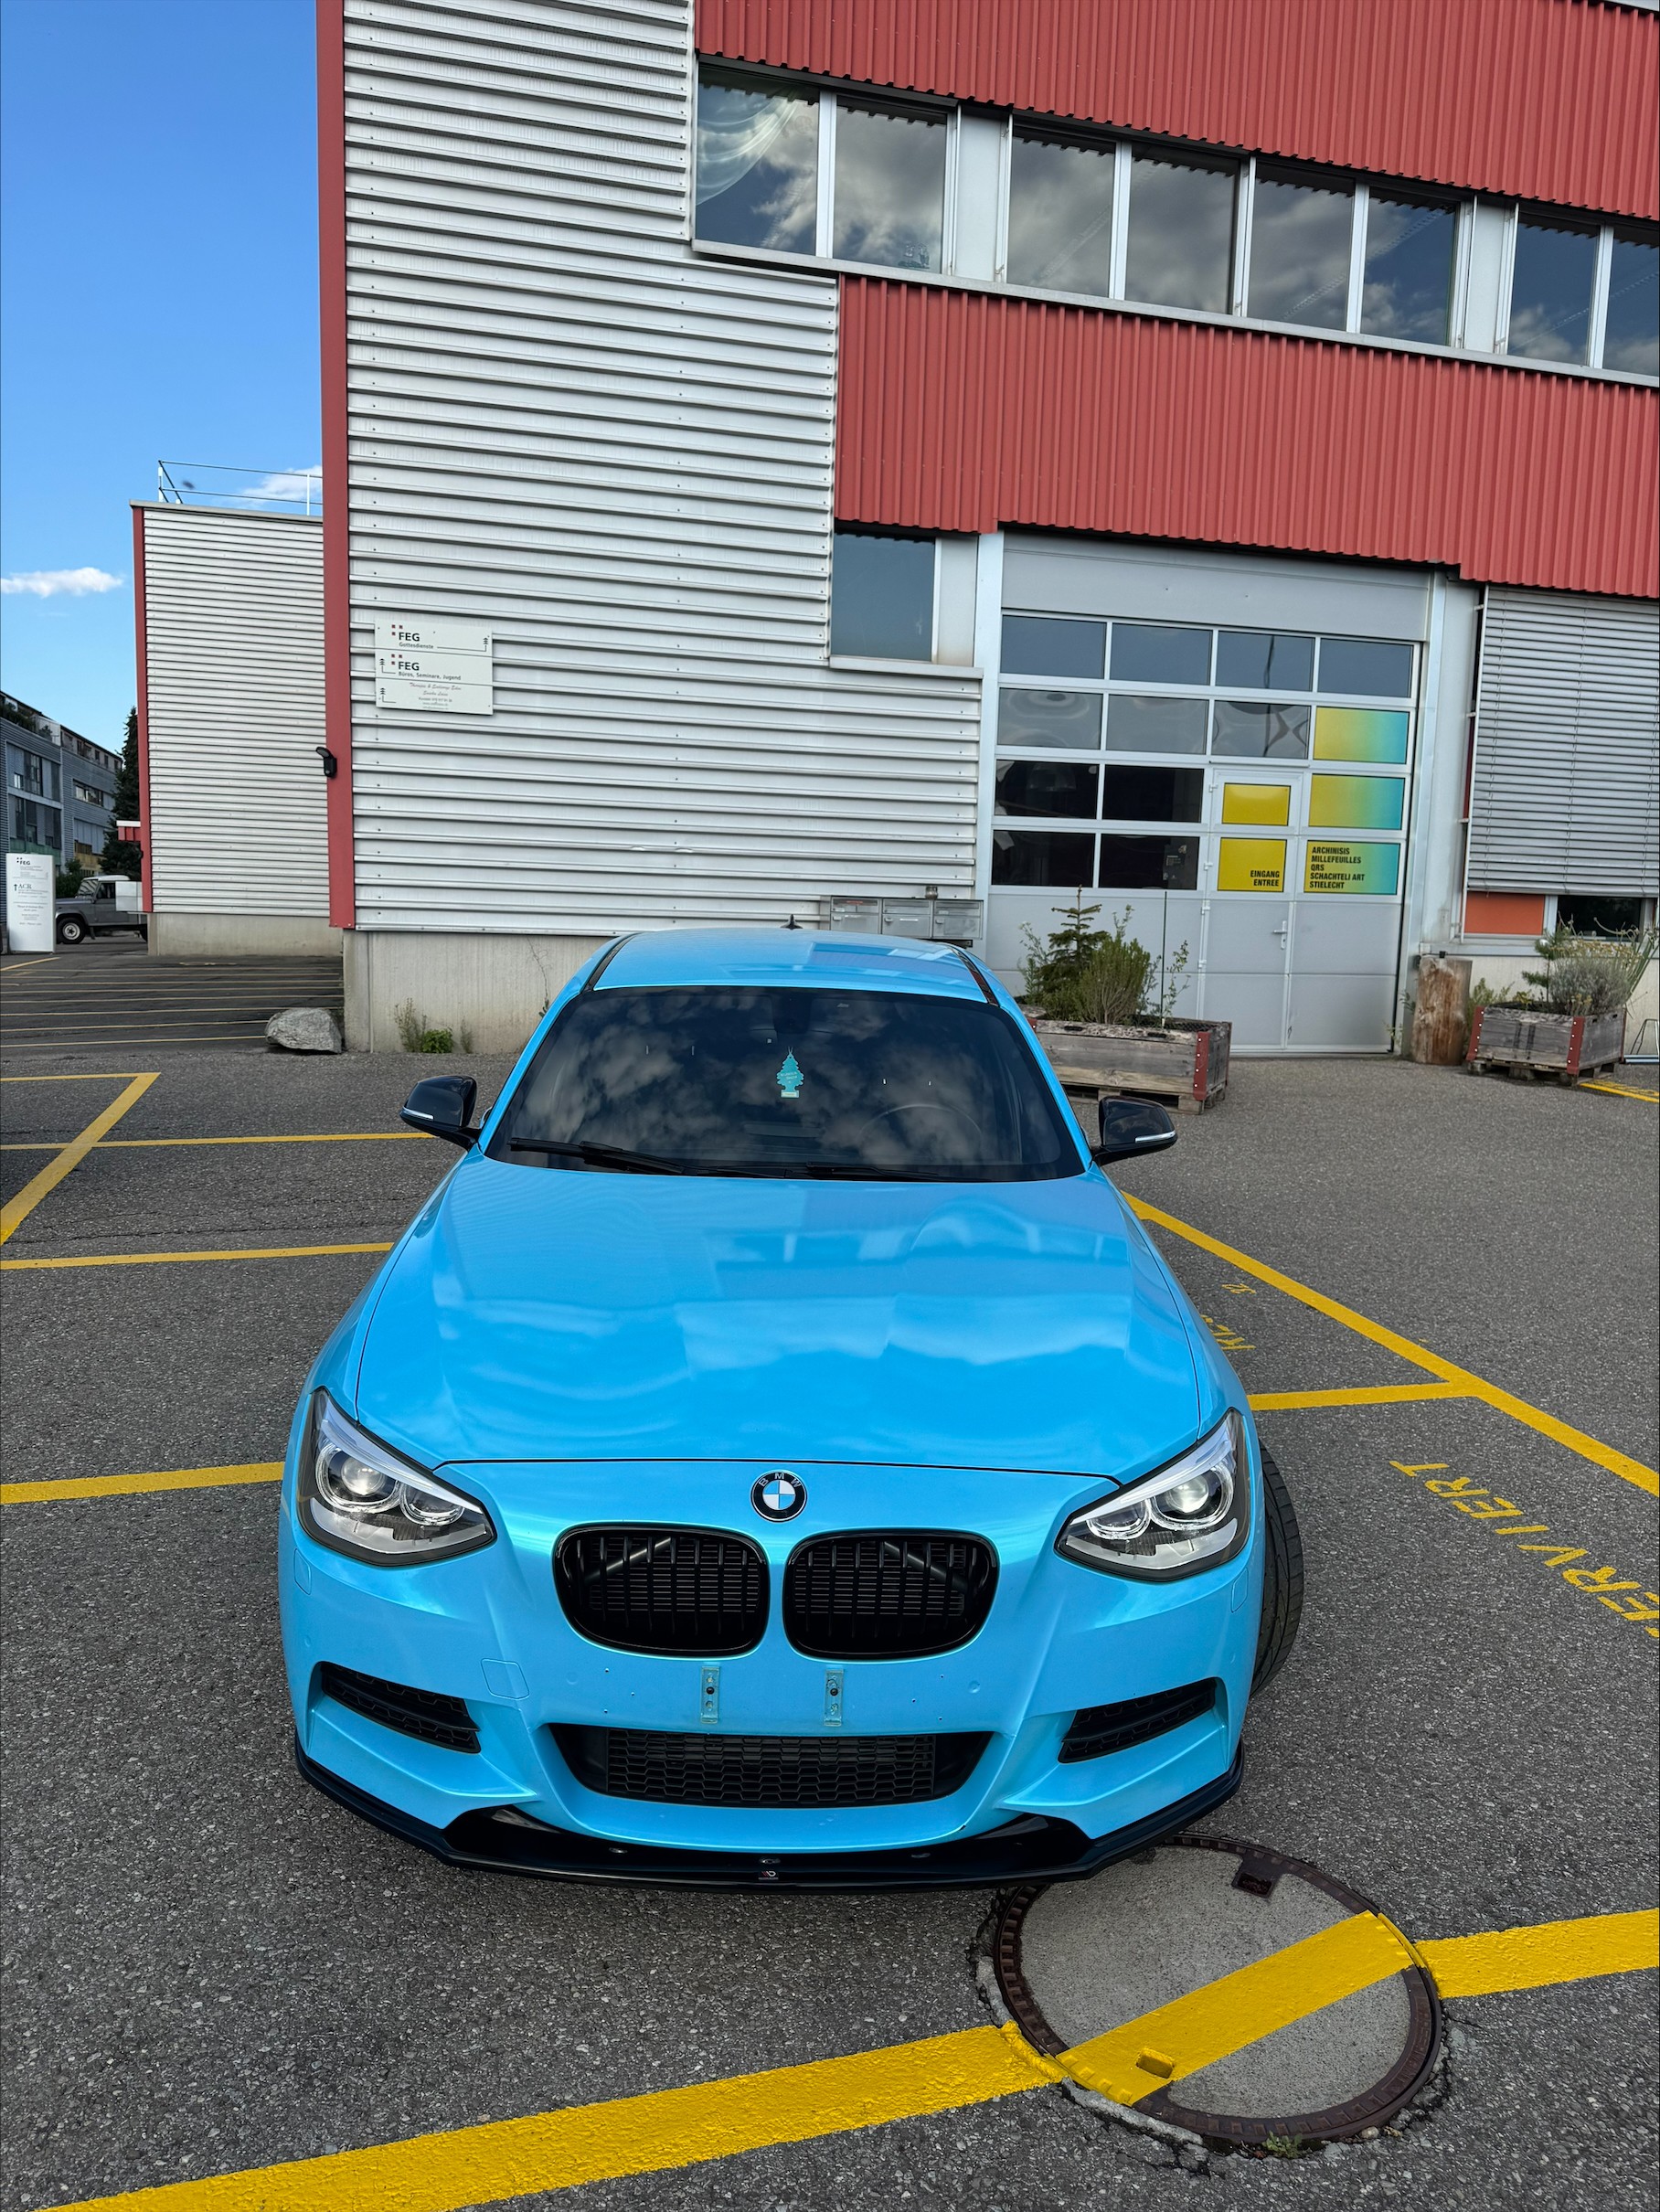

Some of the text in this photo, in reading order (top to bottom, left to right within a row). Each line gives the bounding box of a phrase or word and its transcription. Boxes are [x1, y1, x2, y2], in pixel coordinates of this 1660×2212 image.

[399, 632, 420, 642] FEG
[398, 661, 420, 671] FEG
[1312, 846, 1350, 856] ARCHINISIS
[1311, 855, 1362, 864] MILLEFEUILLES
[1311, 864, 1325, 872] QRS
[1250, 870, 1280, 878] EINGANG
[1310, 872, 1366, 881] SCHACHTELI ART
[1253, 878, 1280, 887] ENTREE
[1309, 880, 1345, 889] STIELECHT
[759, 1473, 802, 1488] BMW
[1389, 1461, 1660, 1638] ERVIERT
